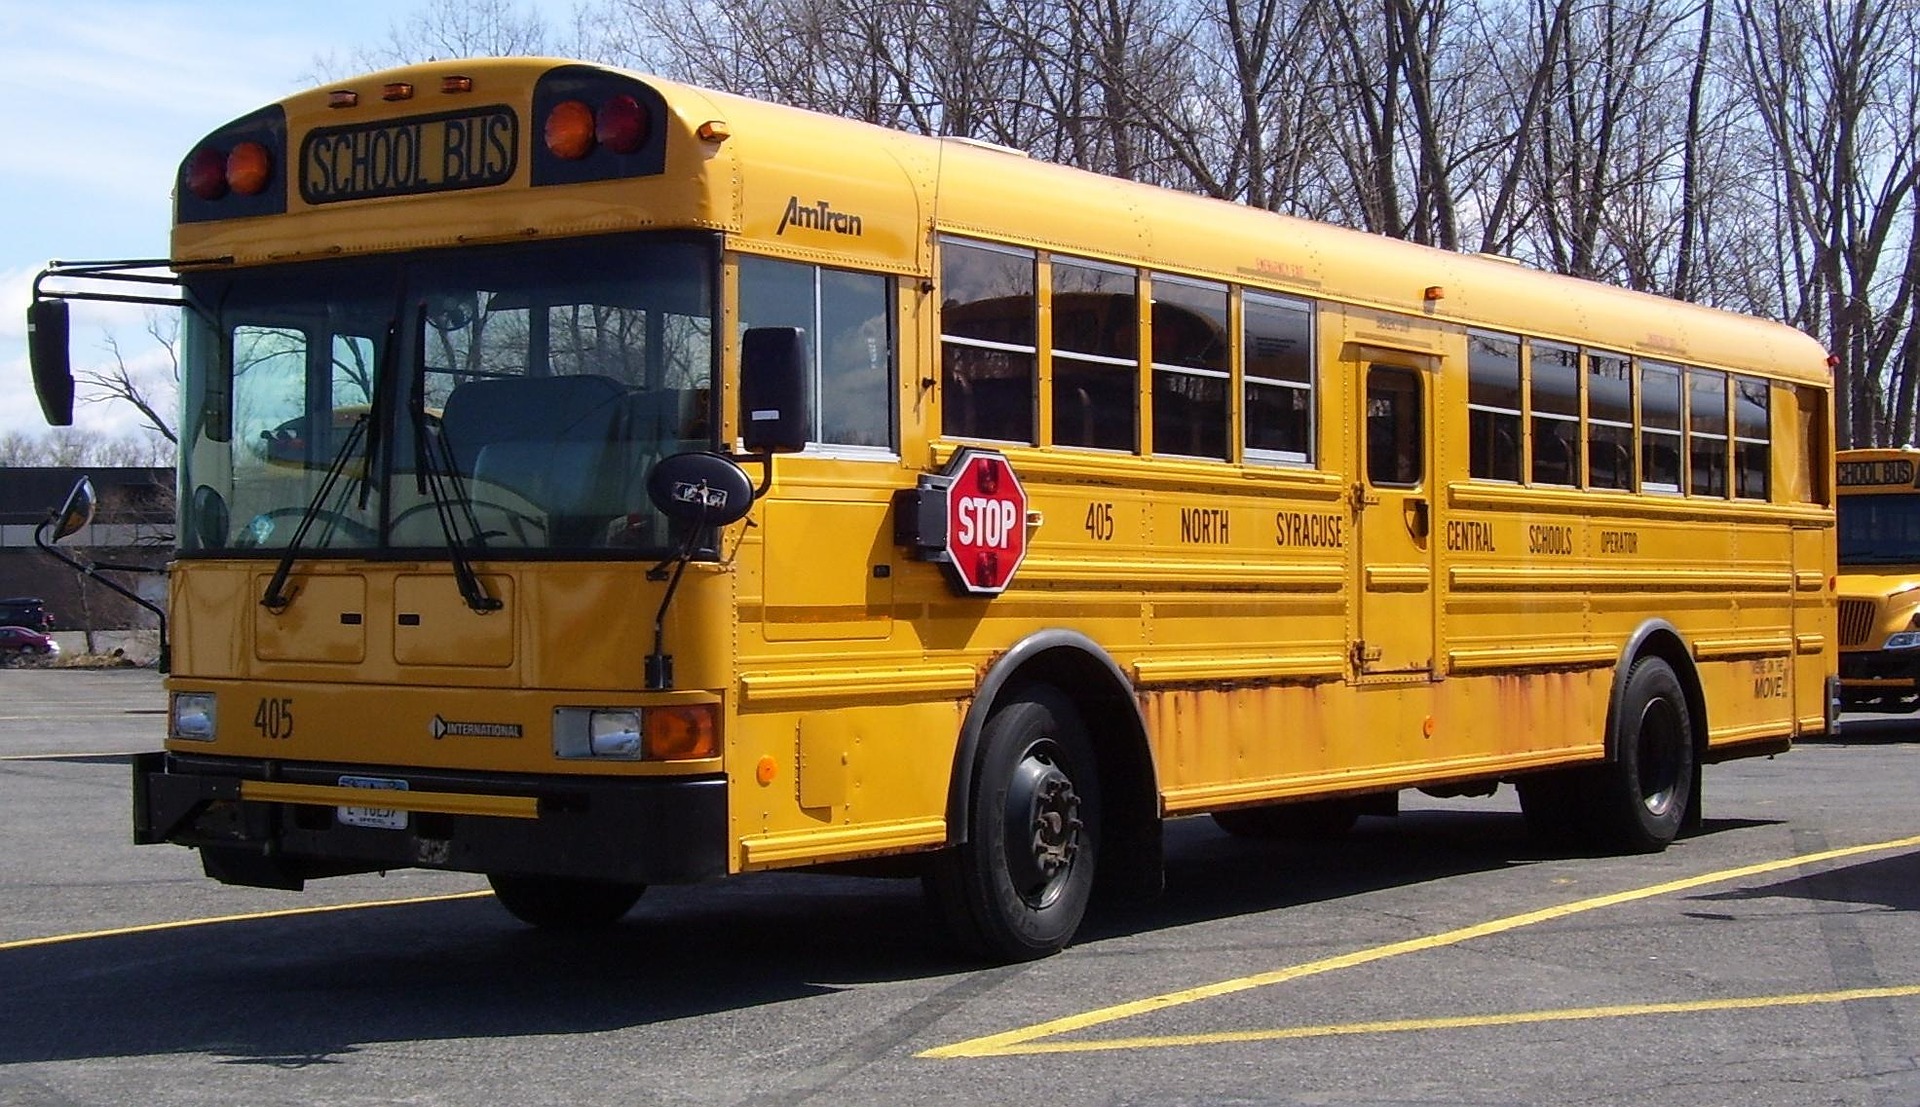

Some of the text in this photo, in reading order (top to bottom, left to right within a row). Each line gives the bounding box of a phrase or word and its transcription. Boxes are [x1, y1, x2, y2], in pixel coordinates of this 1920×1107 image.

[310, 113, 512, 197] SCHOOL BUS
[775, 195, 862, 236] AmTran
[1836, 461, 1910, 484] CHOOL BUS
[958, 496, 1017, 549] STOP
[1085, 502, 1114, 541] 405
[1180, 507, 1639, 555] NORTH SYRACUSE CENTRAL SCHOOLS OPERATOR
[253, 698, 294, 739] 405
[446, 721, 521, 738] INTERNATIONAL
